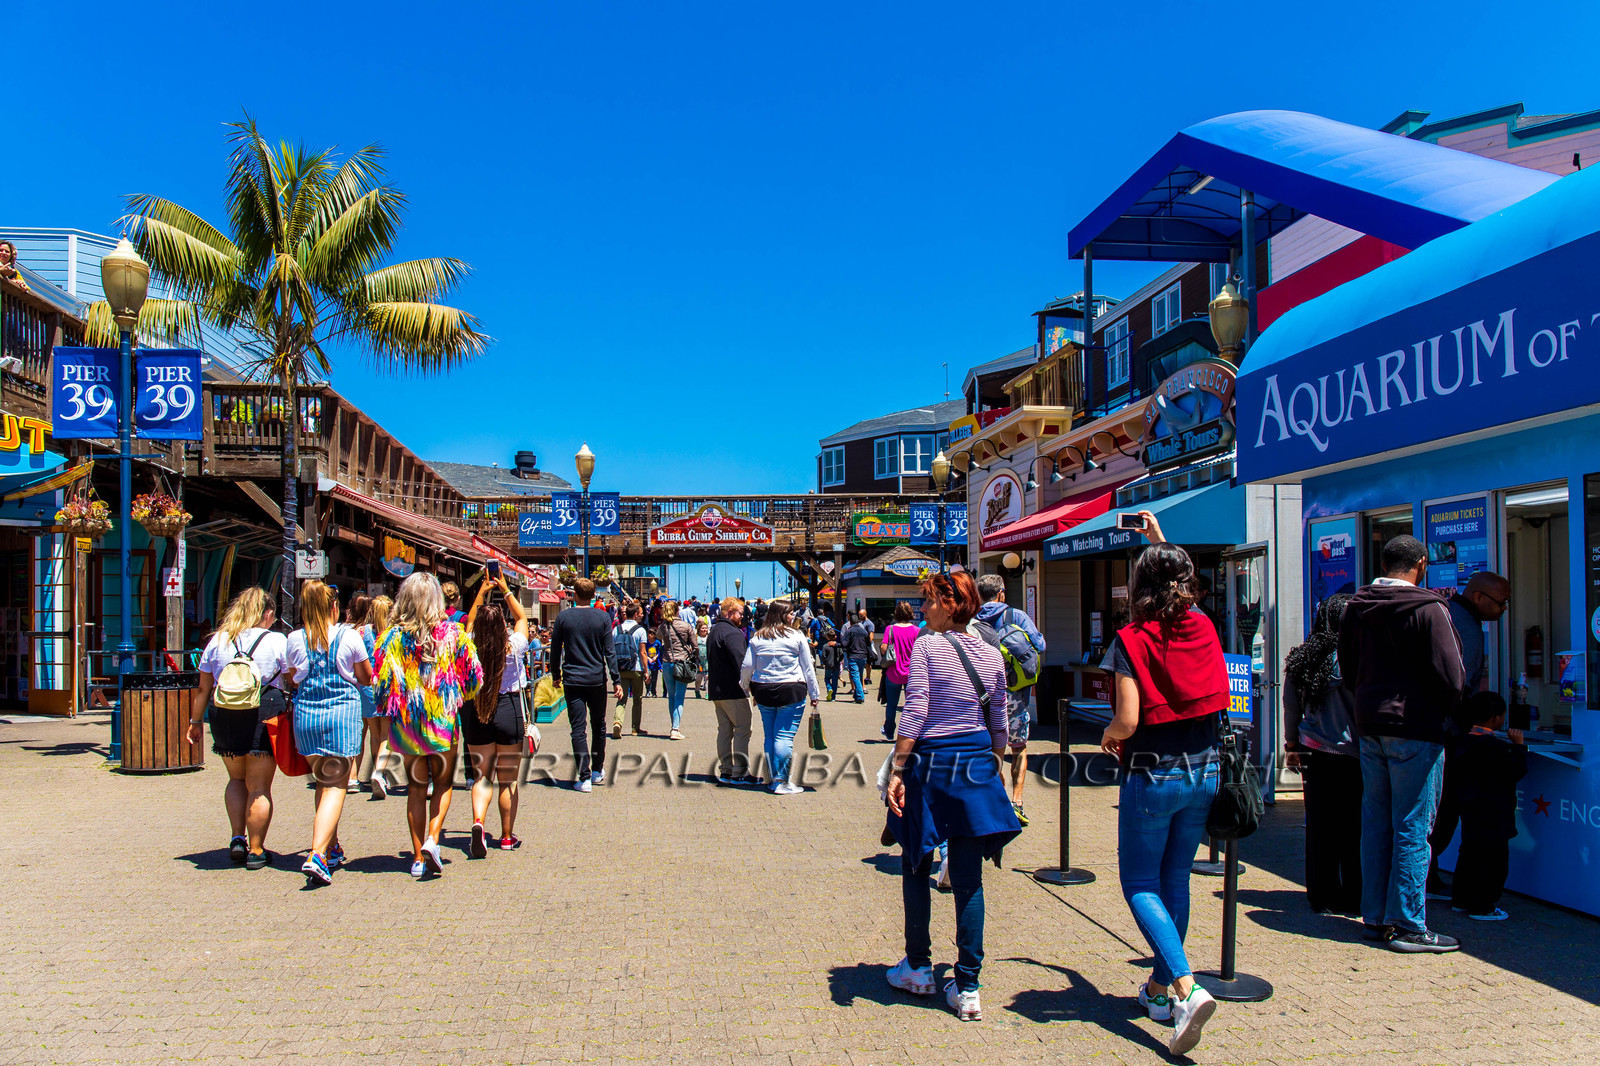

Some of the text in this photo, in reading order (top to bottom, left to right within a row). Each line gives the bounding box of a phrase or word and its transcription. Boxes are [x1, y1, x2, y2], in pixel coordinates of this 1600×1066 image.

[62, 364, 111, 382] PIER
[145, 366, 193, 382] PIER
[1254, 307, 1581, 453] AQUARIUM OF
[1165, 369, 1229, 398] FRANCISCO
[59, 383, 114, 421] 39
[142, 384, 195, 421] 39
[1147, 427, 1220, 464] Whale Tours
[555, 499, 577, 508] PIER
[593, 499, 615, 508] PIER
[554, 508, 579, 527] 39
[592, 508, 617, 527] 39
[913, 510, 934, 519] PIER
[1431, 507, 1484, 523] AQUARIUM TICKETS
[858, 524, 910, 535] PLAYE
[912, 519, 936, 537] 39
[1041, 525, 1054, 534] COFFEE
[1436, 521, 1479, 535] PURCHASE HERE
[1050, 530, 1131, 556] Whale Watching Tours
[1226, 662, 1249, 676] LEASE
[1229, 678, 1249, 693] NTER
[1227, 695, 1250, 713] ERE
